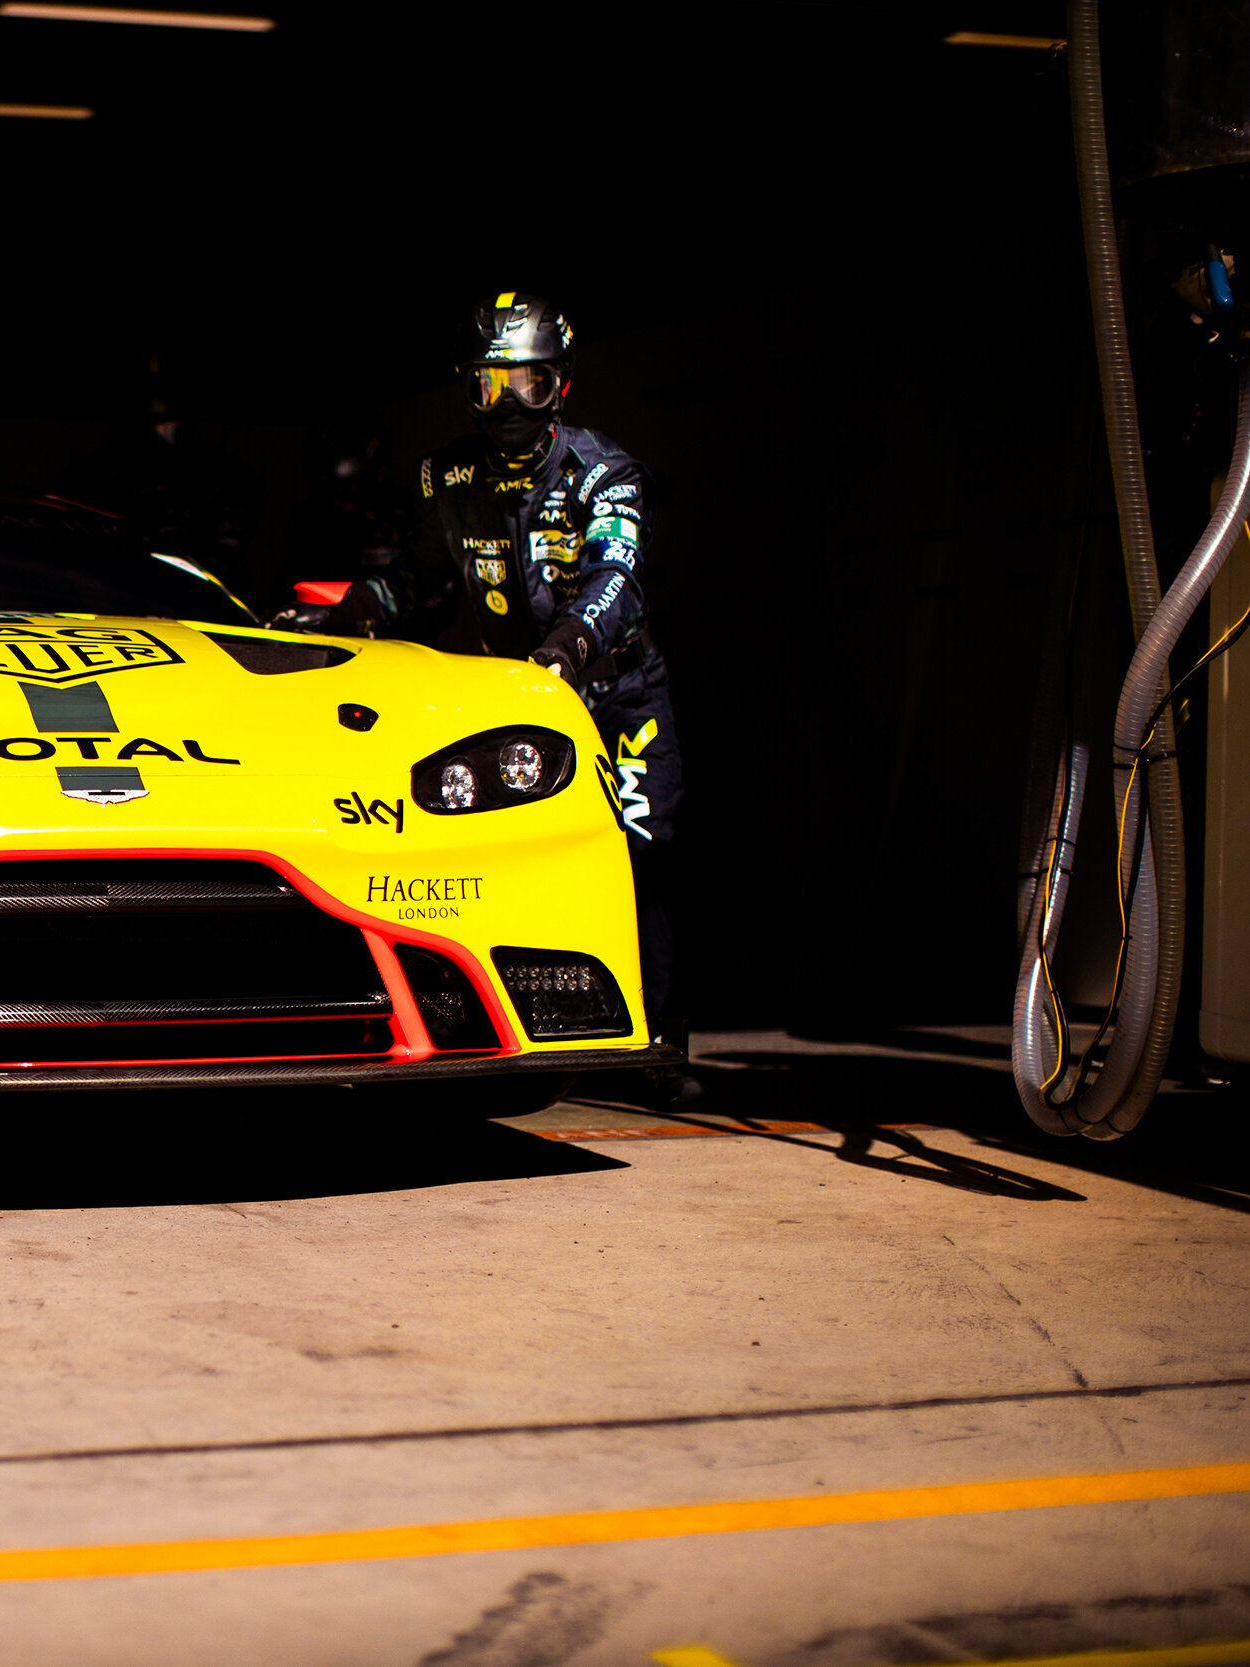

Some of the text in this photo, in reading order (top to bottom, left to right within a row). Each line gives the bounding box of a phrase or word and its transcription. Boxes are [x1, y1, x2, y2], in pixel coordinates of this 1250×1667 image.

[444, 464, 475, 487] sky
[462, 537, 511, 550] HACKETT
[333, 791, 404, 834] sky
[366, 875, 483, 902] HACKETT
[398, 907, 460, 920] LONDON
